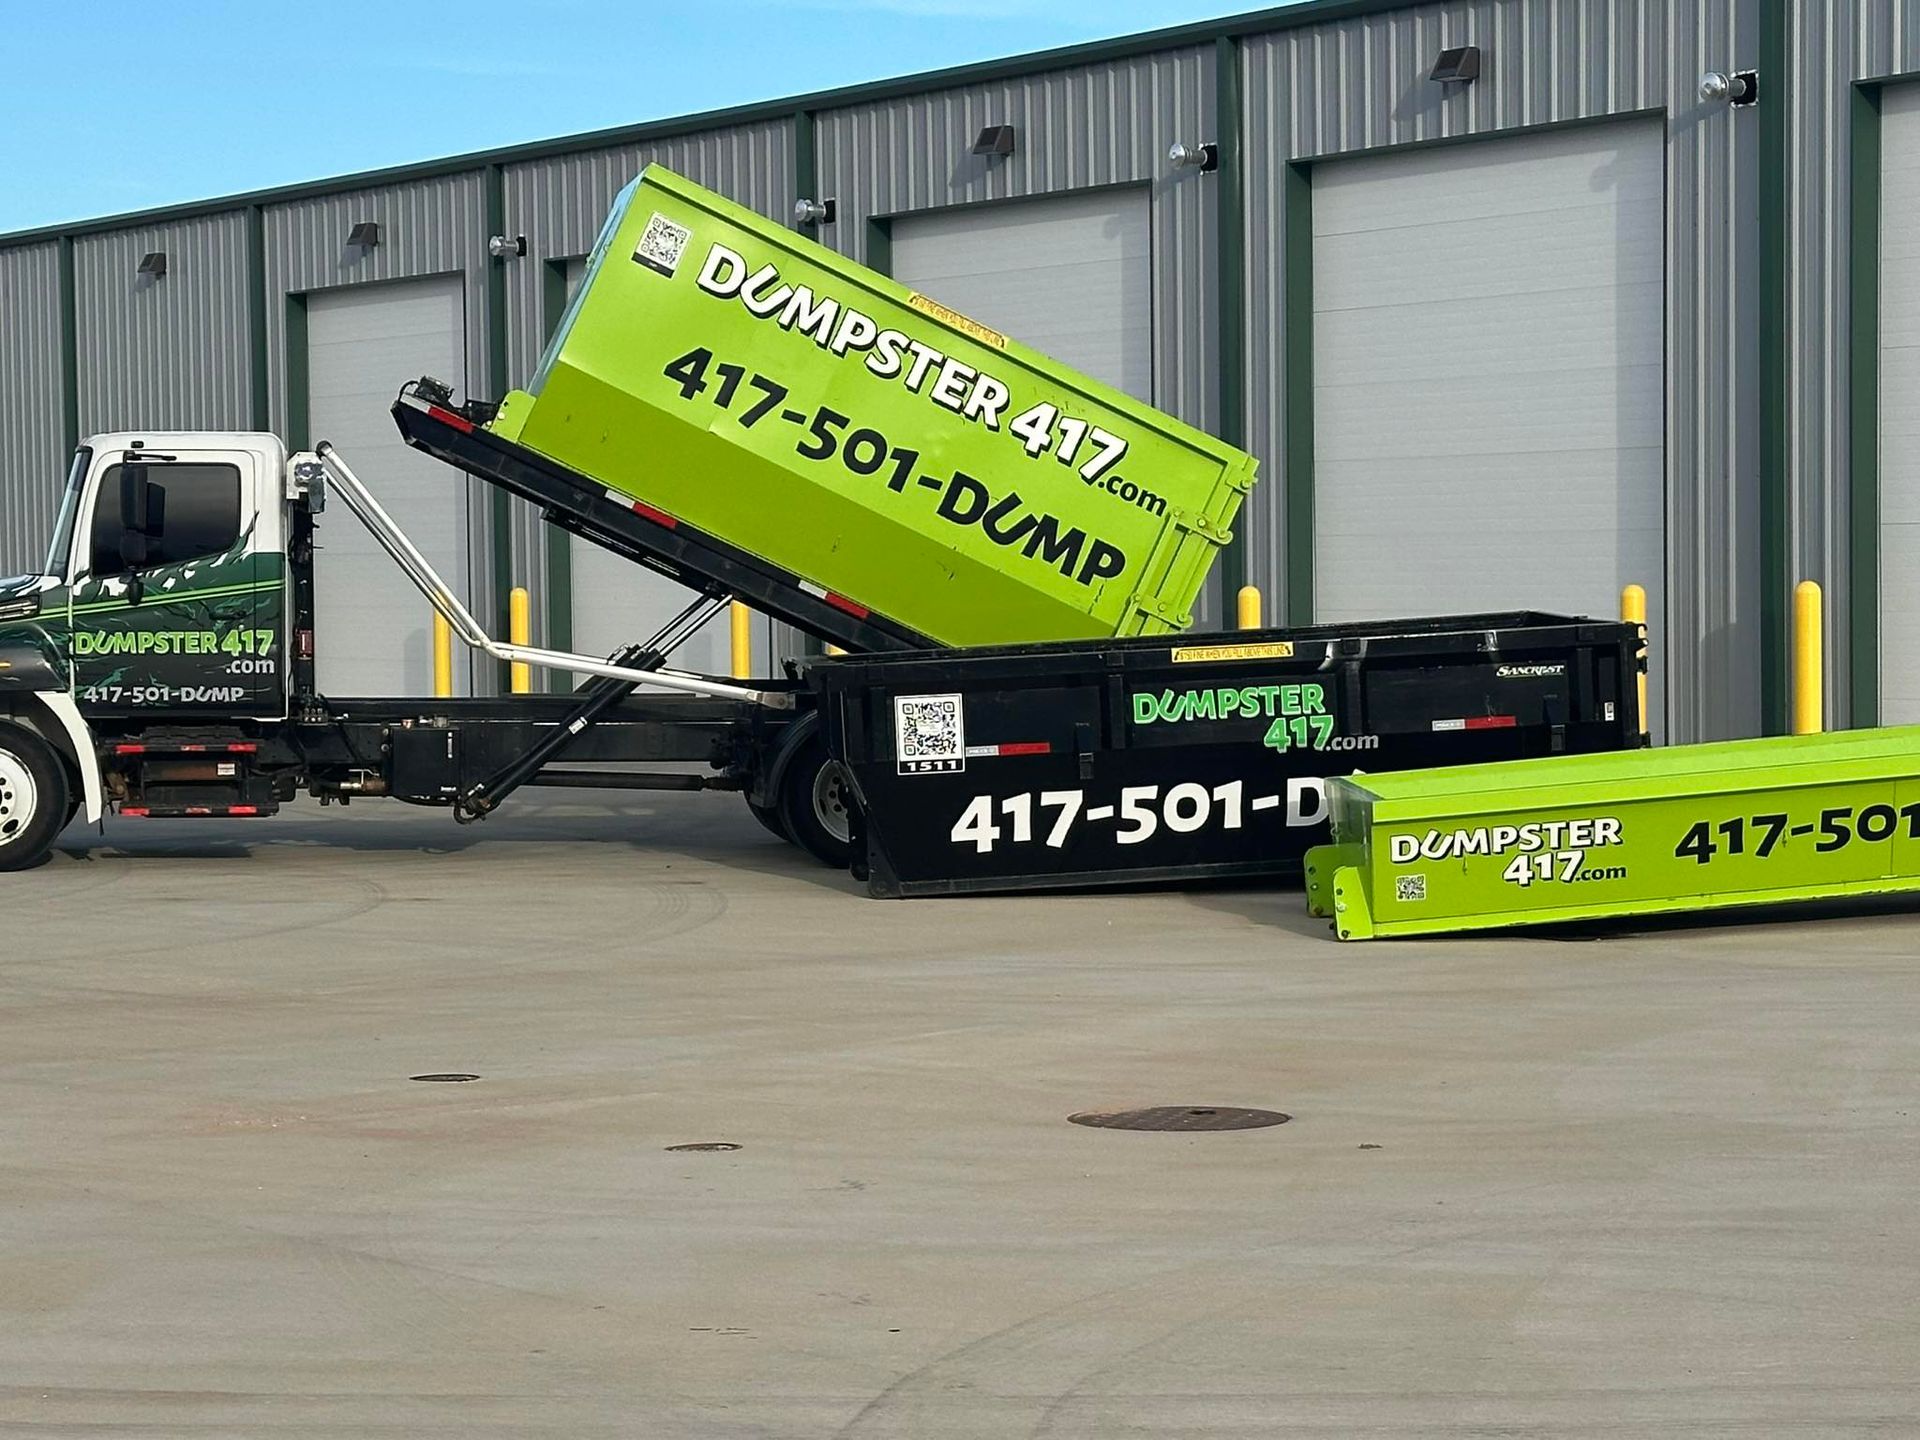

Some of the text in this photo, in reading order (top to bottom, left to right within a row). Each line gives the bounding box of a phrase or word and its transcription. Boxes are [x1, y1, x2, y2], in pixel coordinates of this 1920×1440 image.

[697, 242, 1011, 434] DUMPSTER
[663, 347, 1126, 587] 417-501-DUMP
[75, 629, 274, 657] DUMPSTER 417
[225, 659, 275, 674] .com
[83, 686, 245, 703] 417-501-DUMP
[1132, 684, 1326, 724] DUMPSTER
[907, 760, 957, 772] 1511
[950, 769, 1366, 853] 417-501-D
[1390, 817, 1623, 864] DUMPSTER
